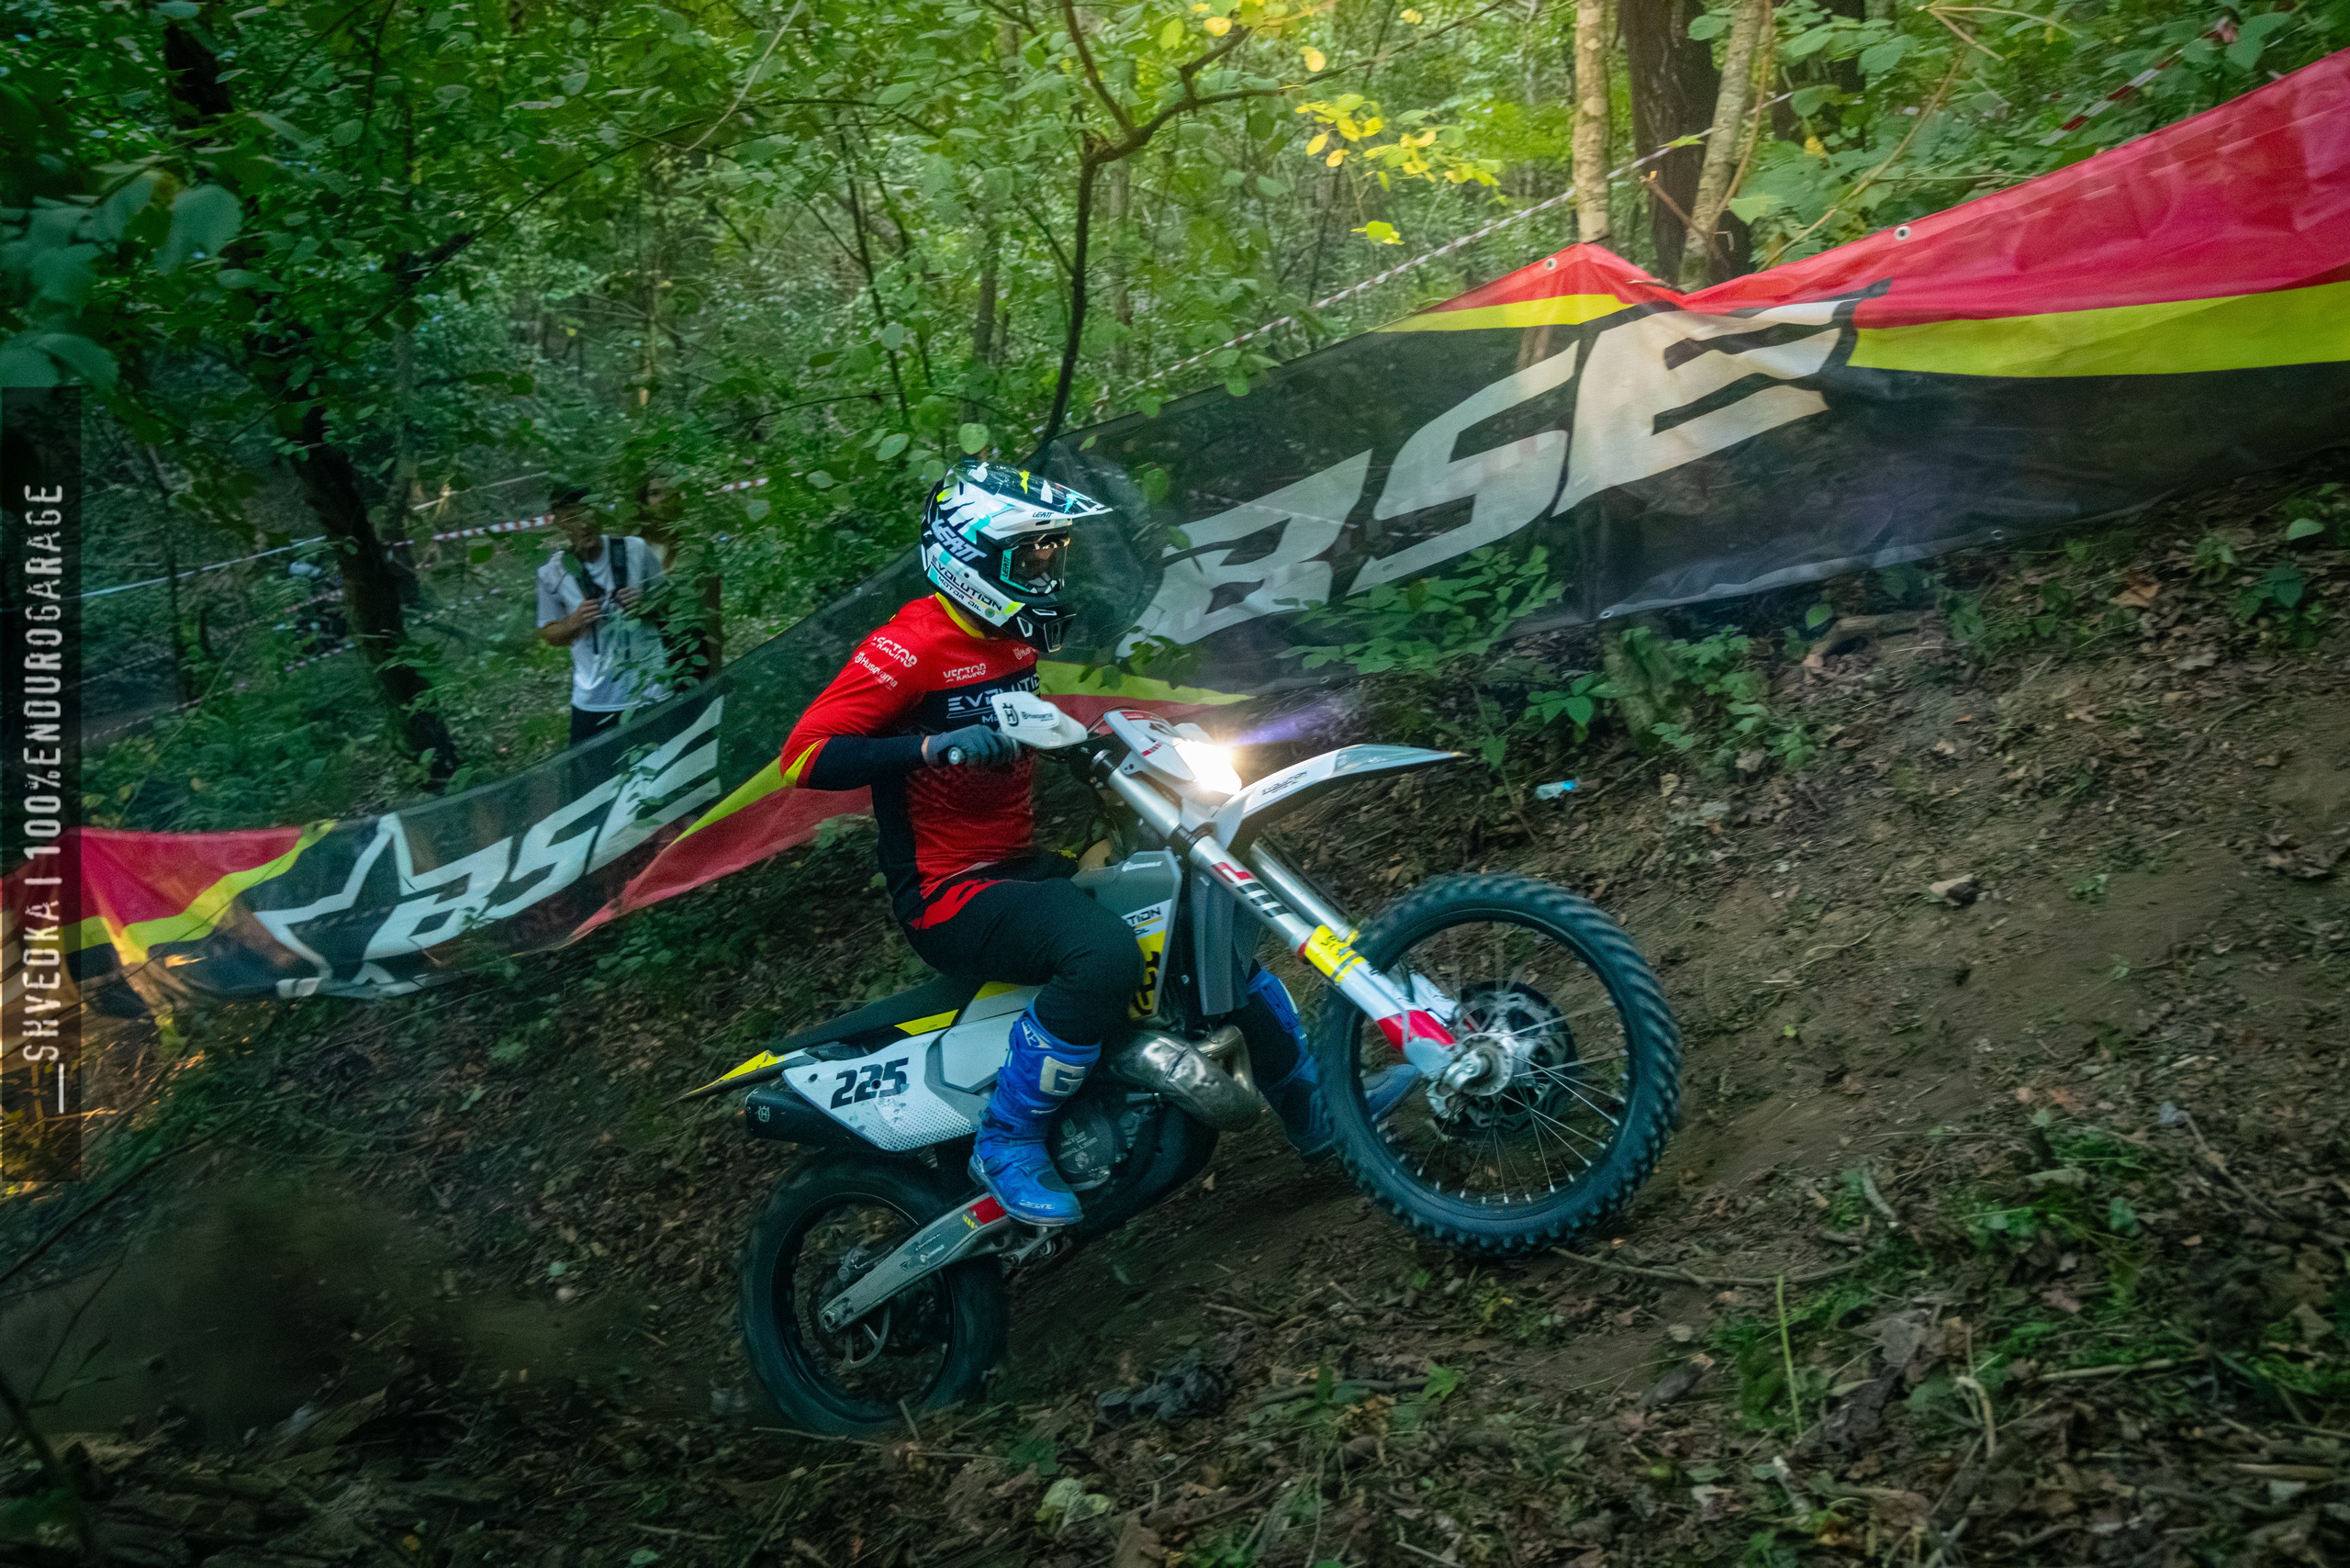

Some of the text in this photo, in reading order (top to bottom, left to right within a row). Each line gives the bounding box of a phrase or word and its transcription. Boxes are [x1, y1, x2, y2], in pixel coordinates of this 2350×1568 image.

[1032, 510, 1055, 519] LEATT
[931, 518, 988, 562] LEATT
[931, 554, 1002, 612] EVOLUTION
[1002, 554, 1011, 578] LEATT
[937, 576, 982, 612] MOTOR OIL
[860, 655, 899, 689] Husqvarna
[830, 1057, 910, 1110] 225
